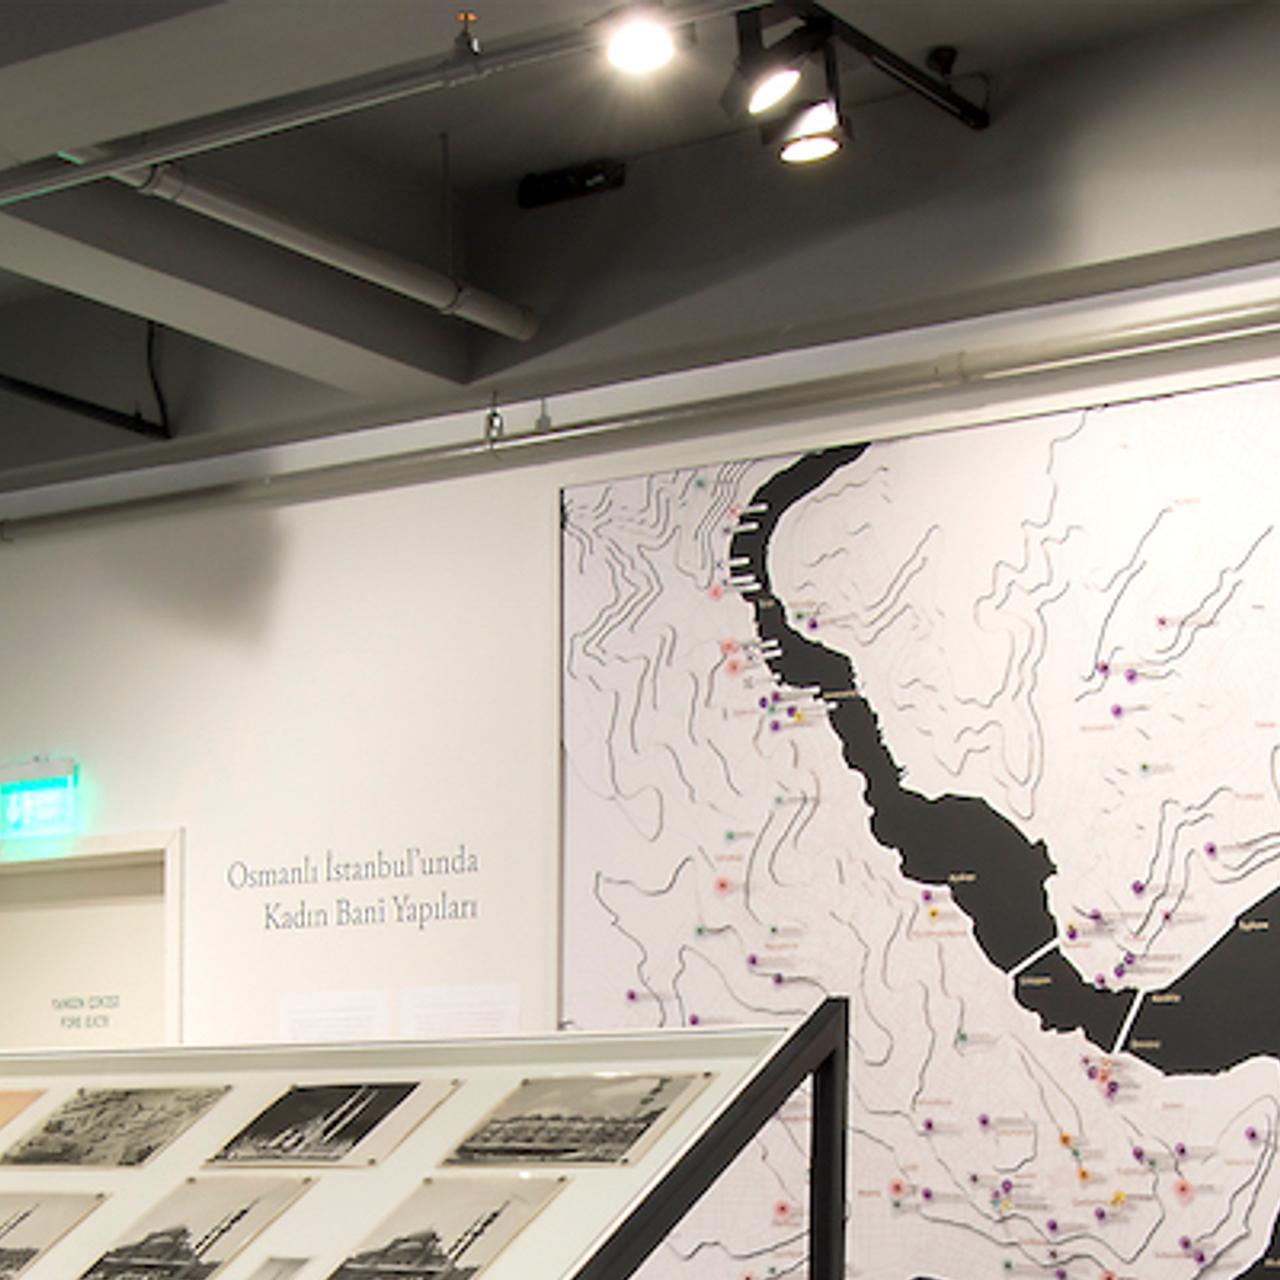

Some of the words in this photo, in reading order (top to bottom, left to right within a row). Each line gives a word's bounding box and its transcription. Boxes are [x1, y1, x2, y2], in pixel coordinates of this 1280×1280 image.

[227, 855, 318, 890] Osmanlı
[264, 900, 329, 930] Kadın
[336, 898, 385, 926] Bani
[392, 890, 478, 931] Yapıları
